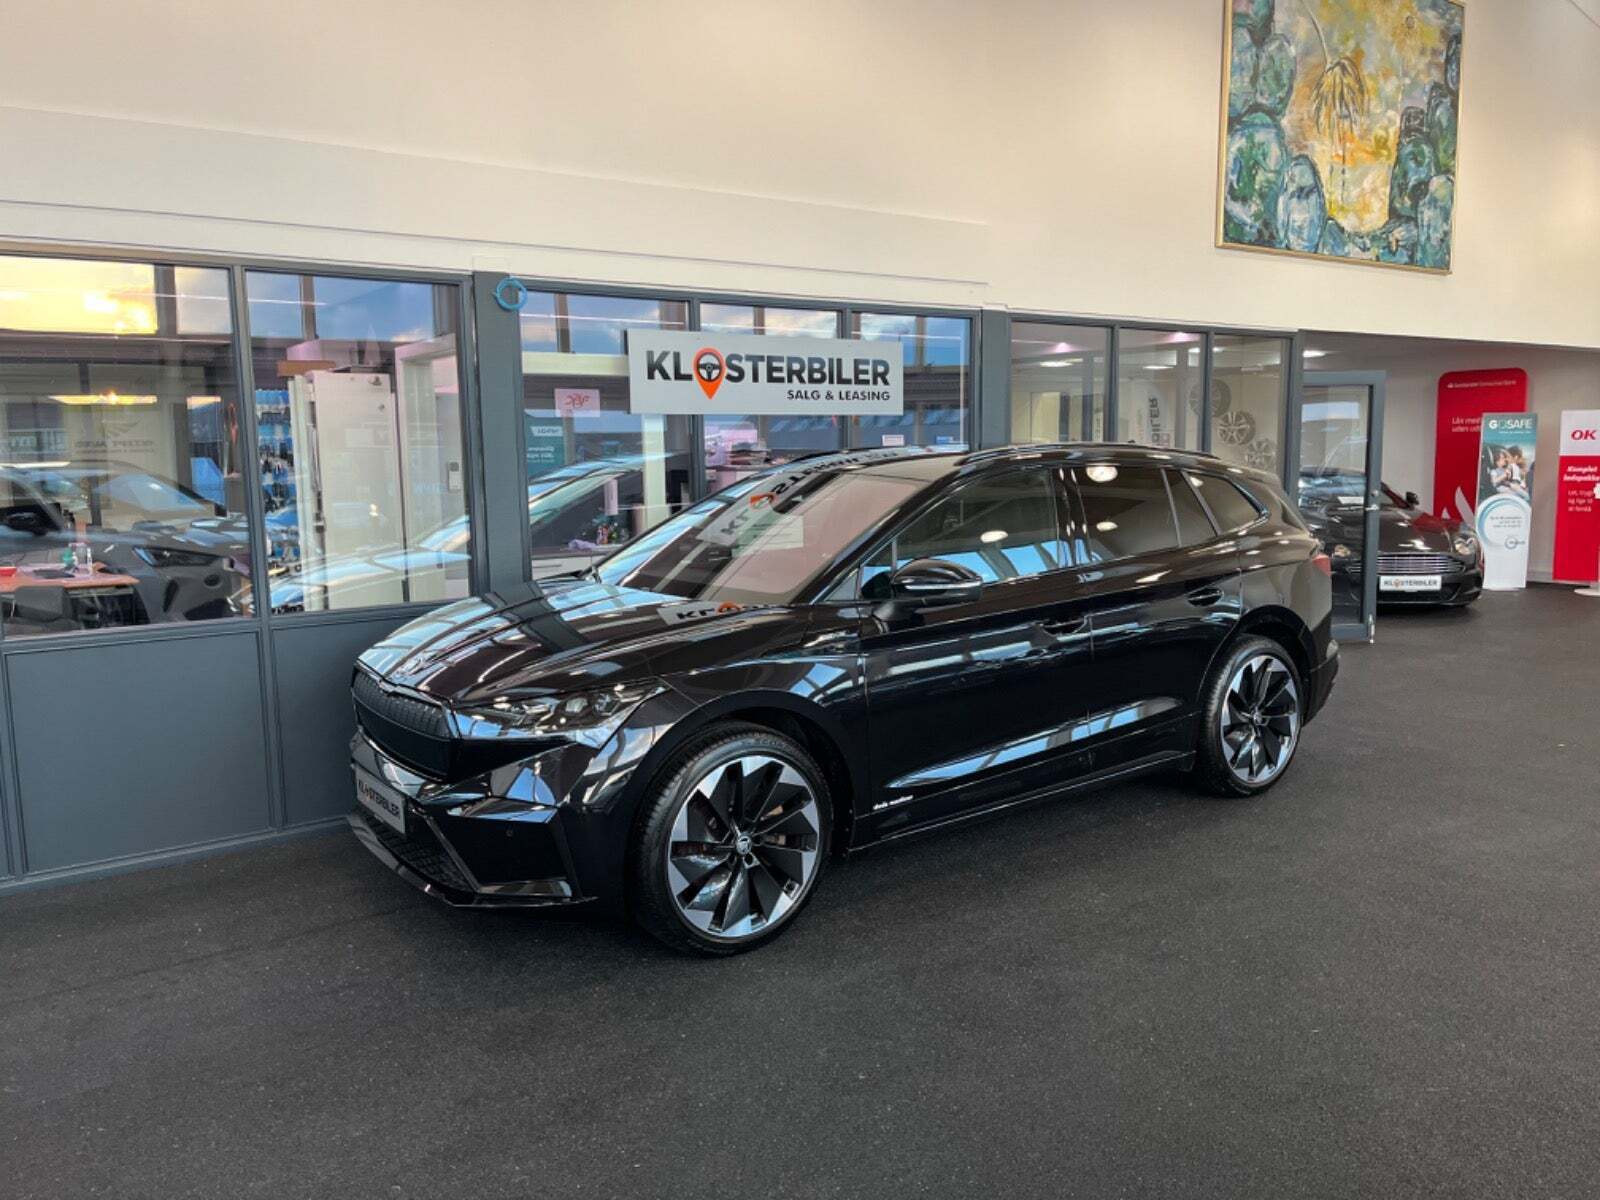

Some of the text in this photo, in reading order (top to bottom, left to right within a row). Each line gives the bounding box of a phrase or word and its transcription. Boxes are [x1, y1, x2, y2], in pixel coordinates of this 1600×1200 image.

[787, 390, 890, 401] SALG & LEASING
[1571, 429, 1598, 441] OK
